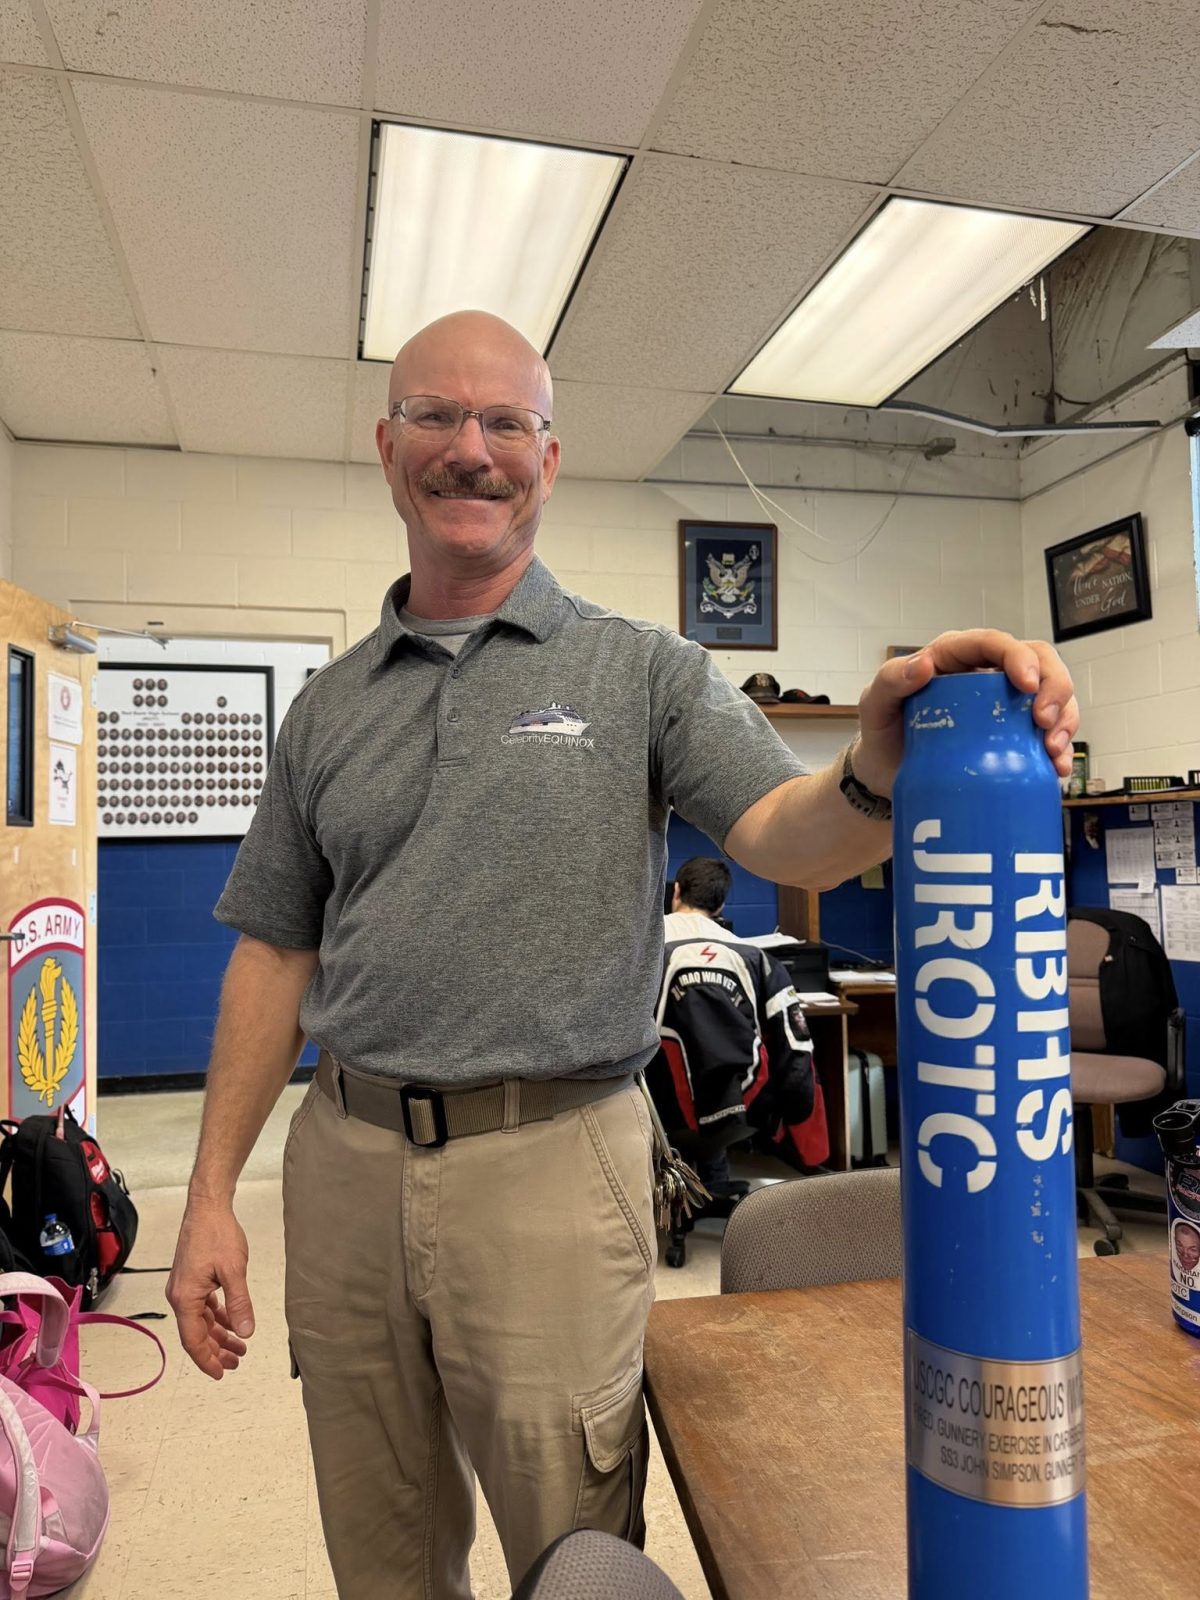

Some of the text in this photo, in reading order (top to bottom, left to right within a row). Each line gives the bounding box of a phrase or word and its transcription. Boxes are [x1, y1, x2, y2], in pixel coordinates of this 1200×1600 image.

[15, 914, 80, 953] U.S. ARMY
[679, 971, 737, 992] IRAQ WAR VET
[912, 819, 998, 1194] JROTC
[1014, 853, 1073, 1162] RBHS
[958, 1377, 1064, 1423] COURAGEOUS
[937, 1418, 986, 1449] GUNNERY
[988, 1433, 1041, 1455] EXERCISE
[1043, 1434, 1053, 1454] IN
[960, 1456, 989, 1478] JOHN
